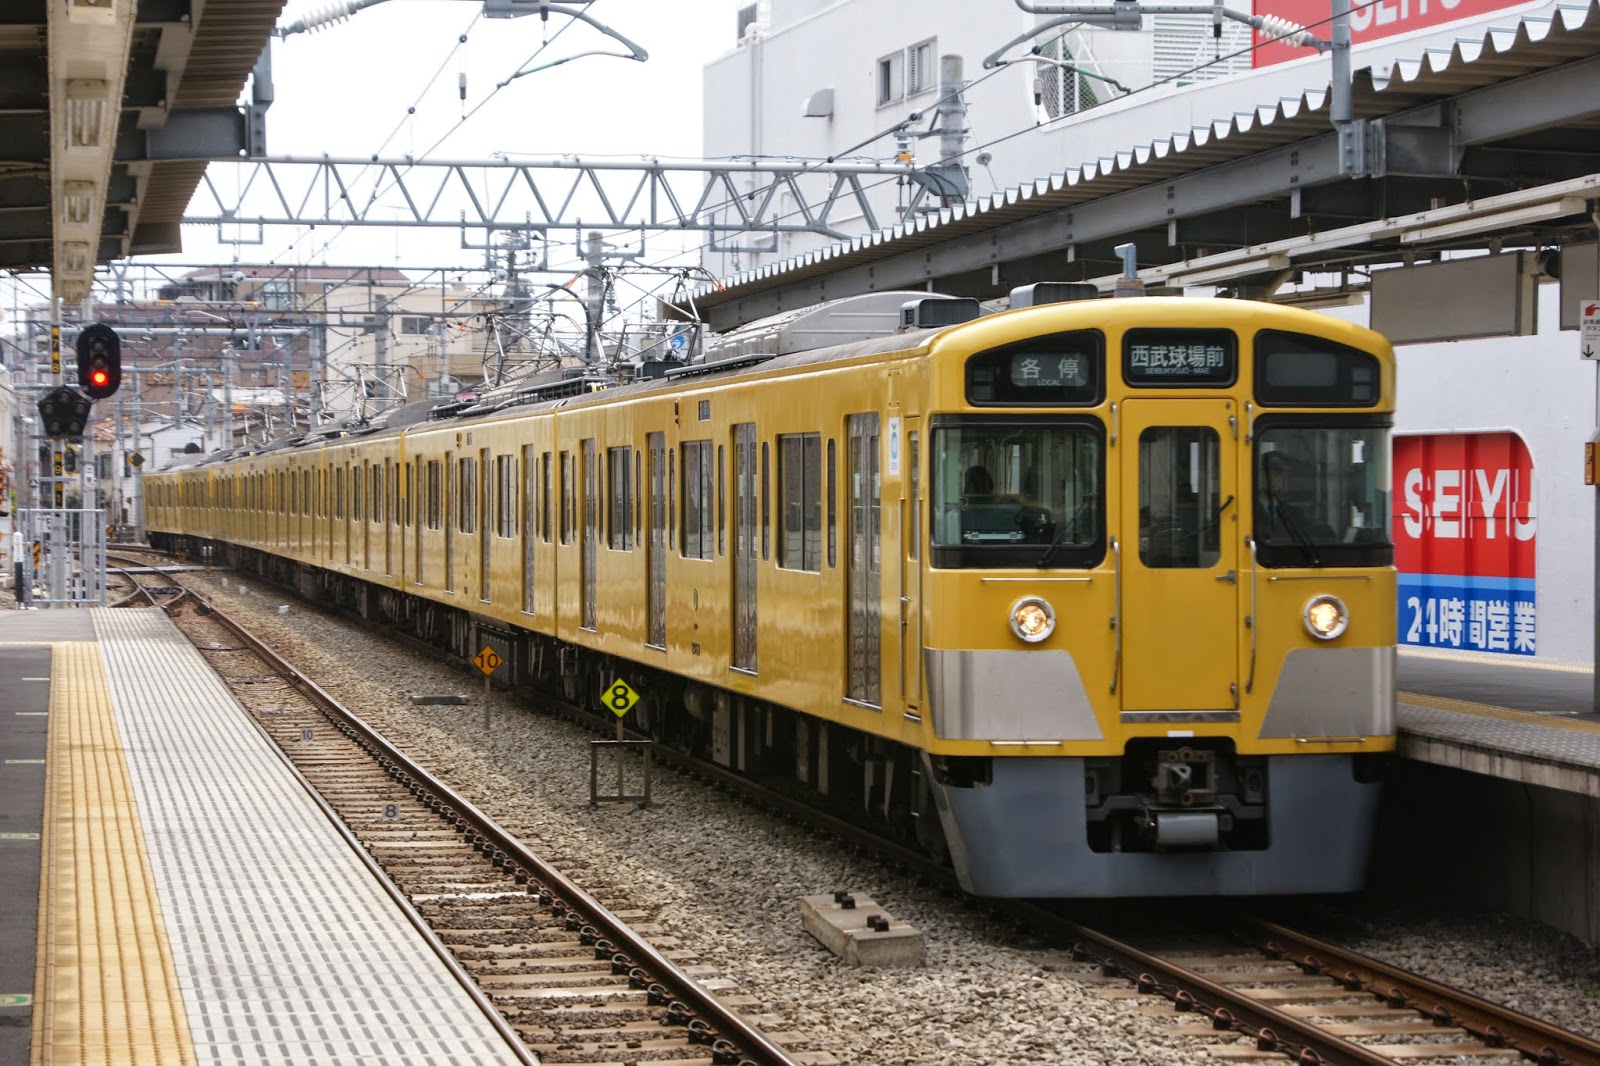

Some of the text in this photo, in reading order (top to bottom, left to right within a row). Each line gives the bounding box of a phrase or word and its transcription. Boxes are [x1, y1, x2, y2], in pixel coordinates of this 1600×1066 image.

[1131, 345, 1225, 367] 西武球場前
[1406, 596, 1536, 652] 24時間営業
[478, 653, 498, 669] 10
[611, 684, 630, 710] 8
[302, 729, 313, 740] 10
[385, 804, 397, 818] 8
